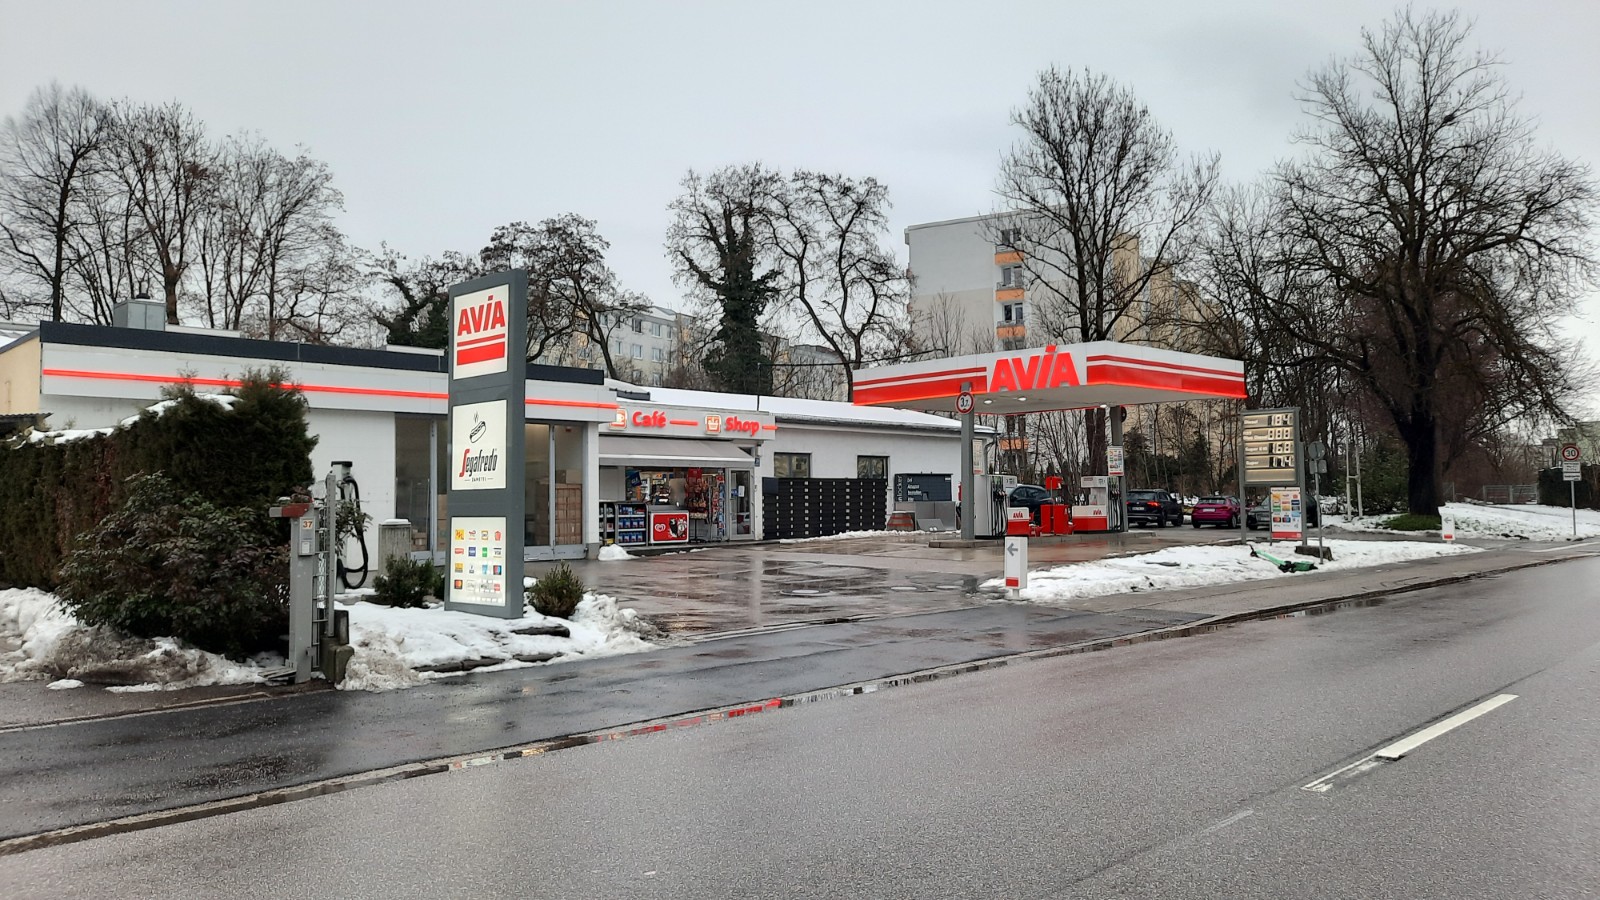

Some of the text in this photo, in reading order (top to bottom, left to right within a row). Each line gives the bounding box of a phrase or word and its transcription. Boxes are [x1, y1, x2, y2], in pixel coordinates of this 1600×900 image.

[457, 295, 506, 336] AVIA
[990, 344, 1080, 392] AVIA
[632, 411, 666, 428] Café
[725, 416, 760, 437] Shop
[459, 449, 498, 477] Segafredo
[1565, 449, 1576, 457] 30
